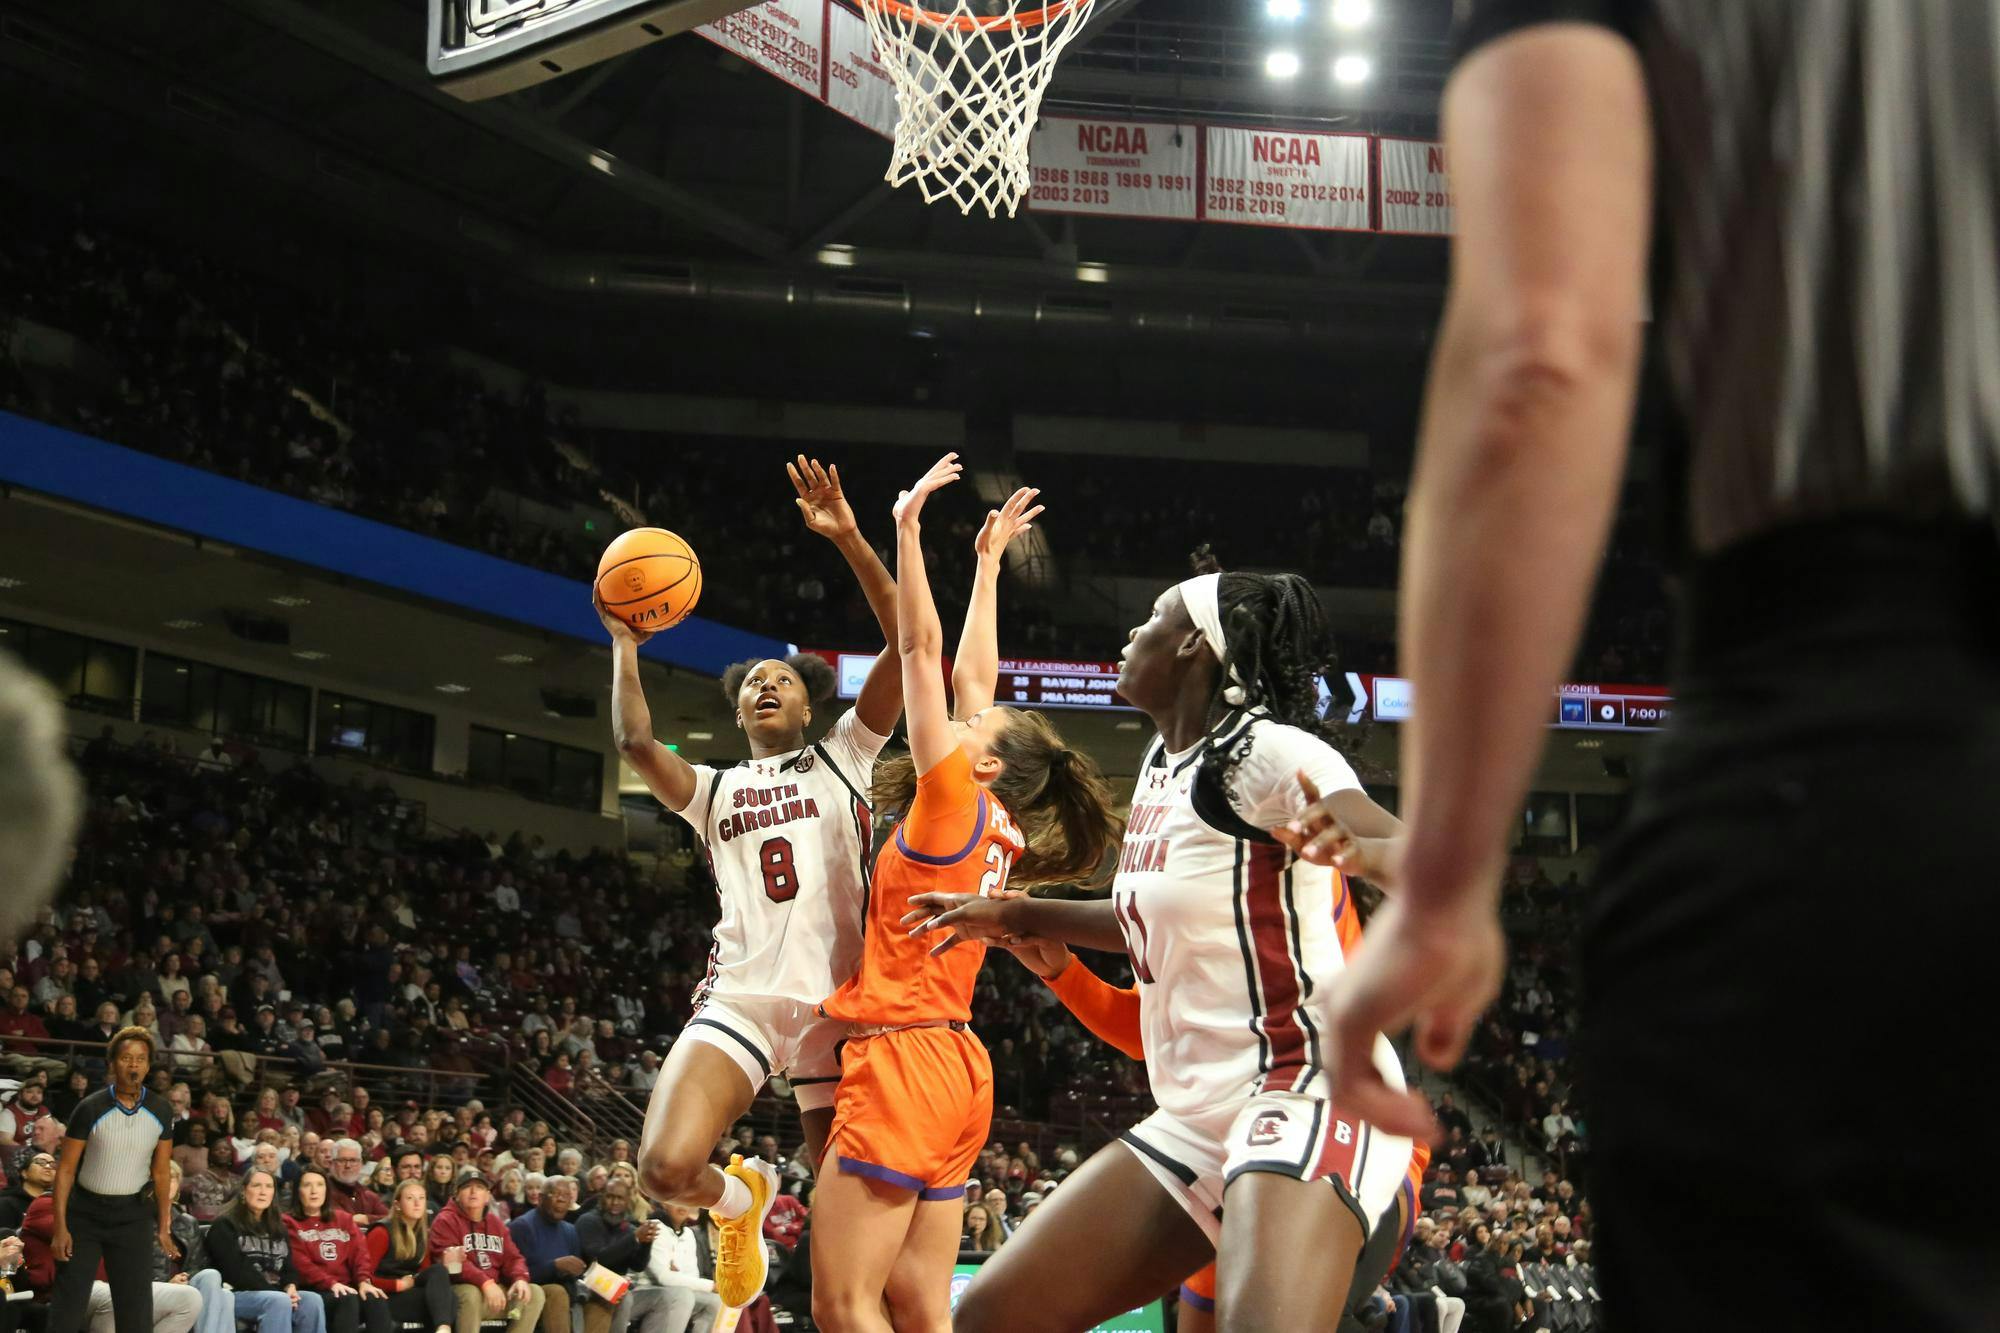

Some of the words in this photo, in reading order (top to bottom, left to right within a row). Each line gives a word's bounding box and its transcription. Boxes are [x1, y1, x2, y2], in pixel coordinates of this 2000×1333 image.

[731, 9, 759, 30] 016
[762, 20, 788, 47] 2017
[791, 36, 818, 64] 2018
[832, 60, 858, 89] 2025
[1078, 124, 1148, 154] NCAA
[1253, 135, 1320, 167] NCAA
[1086, 156, 1141, 168] TOURNAMENT
[1267, 166, 1294, 176] SWEET
[1034, 167, 1069, 184] 1986
[1074, 169, 1109, 187] 1988
[1116, 172, 1152, 189] 1989
[1158, 175, 1191, 191] 1991
[1209, 176, 1244, 194] 1982
[1249, 179, 1284, 197] 1990
[1291, 183, 1326, 200] 2012
[1329, 186, 1365, 202] 2014
[1033, 185, 1069, 202] 2003
[1073, 188, 1109, 205] 2013
[1209, 195, 1245, 211] 2016
[1250, 198, 1286, 215] 2019
[1386, 190, 1420, 207] 2002
[1426, 191, 1450, 208] 201
[1018, 661, 1101, 673] LEADERBOARD
[1041, 677, 1085, 689] RAVEN
[1086, 680, 1117, 690] JOHN
[1041, 691, 1065, 702] MIA
[1066, 693, 1112, 704] MOORE
[1629, 708, 1656, 719] 7:00
[794, 754, 815, 773] SEC
[732, 783, 799, 809] SOUTH
[718, 798, 820, 842] CAROLINA
[759, 836, 800, 903] 8
[978, 840, 1014, 898] 21
[1334, 1119, 1353, 1146] B
